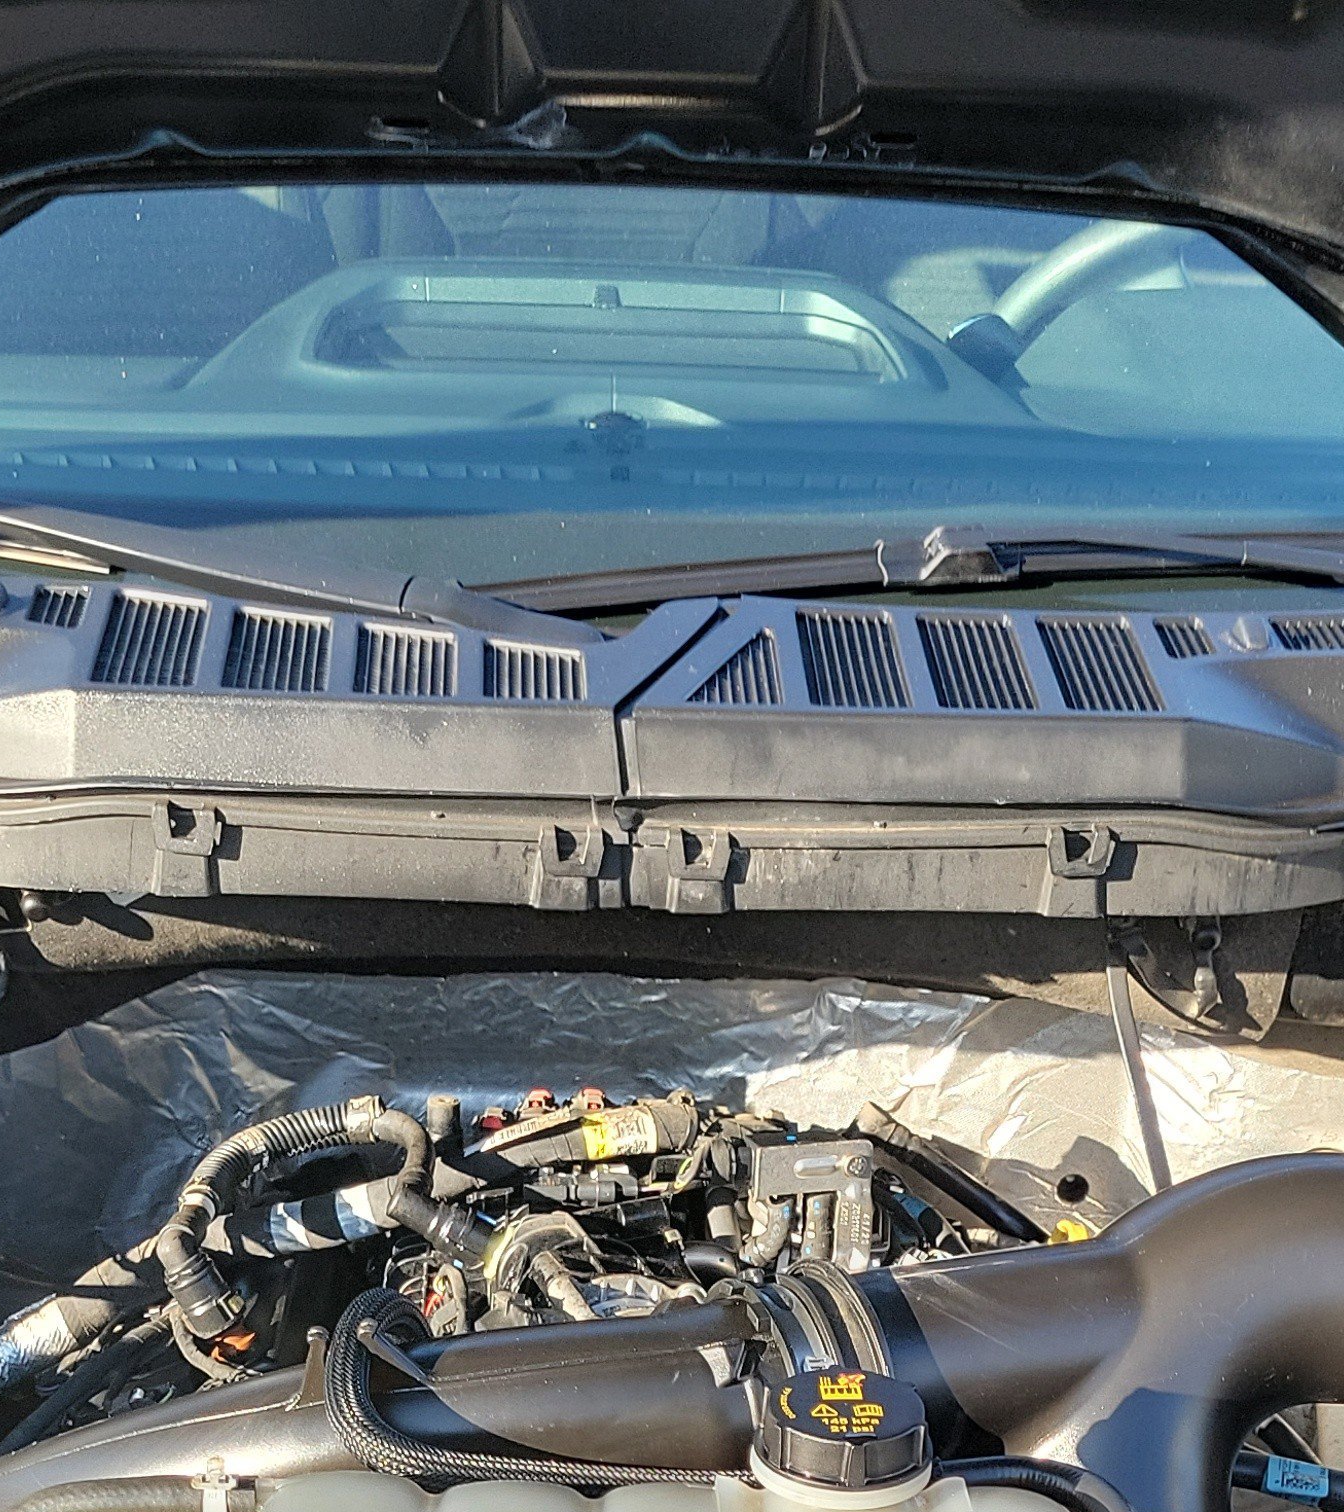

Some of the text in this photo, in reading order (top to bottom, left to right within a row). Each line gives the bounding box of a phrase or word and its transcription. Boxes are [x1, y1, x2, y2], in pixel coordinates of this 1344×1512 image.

[851, 1416, 880, 1425] kPa
[830, 1425, 875, 1434] 21 psi
